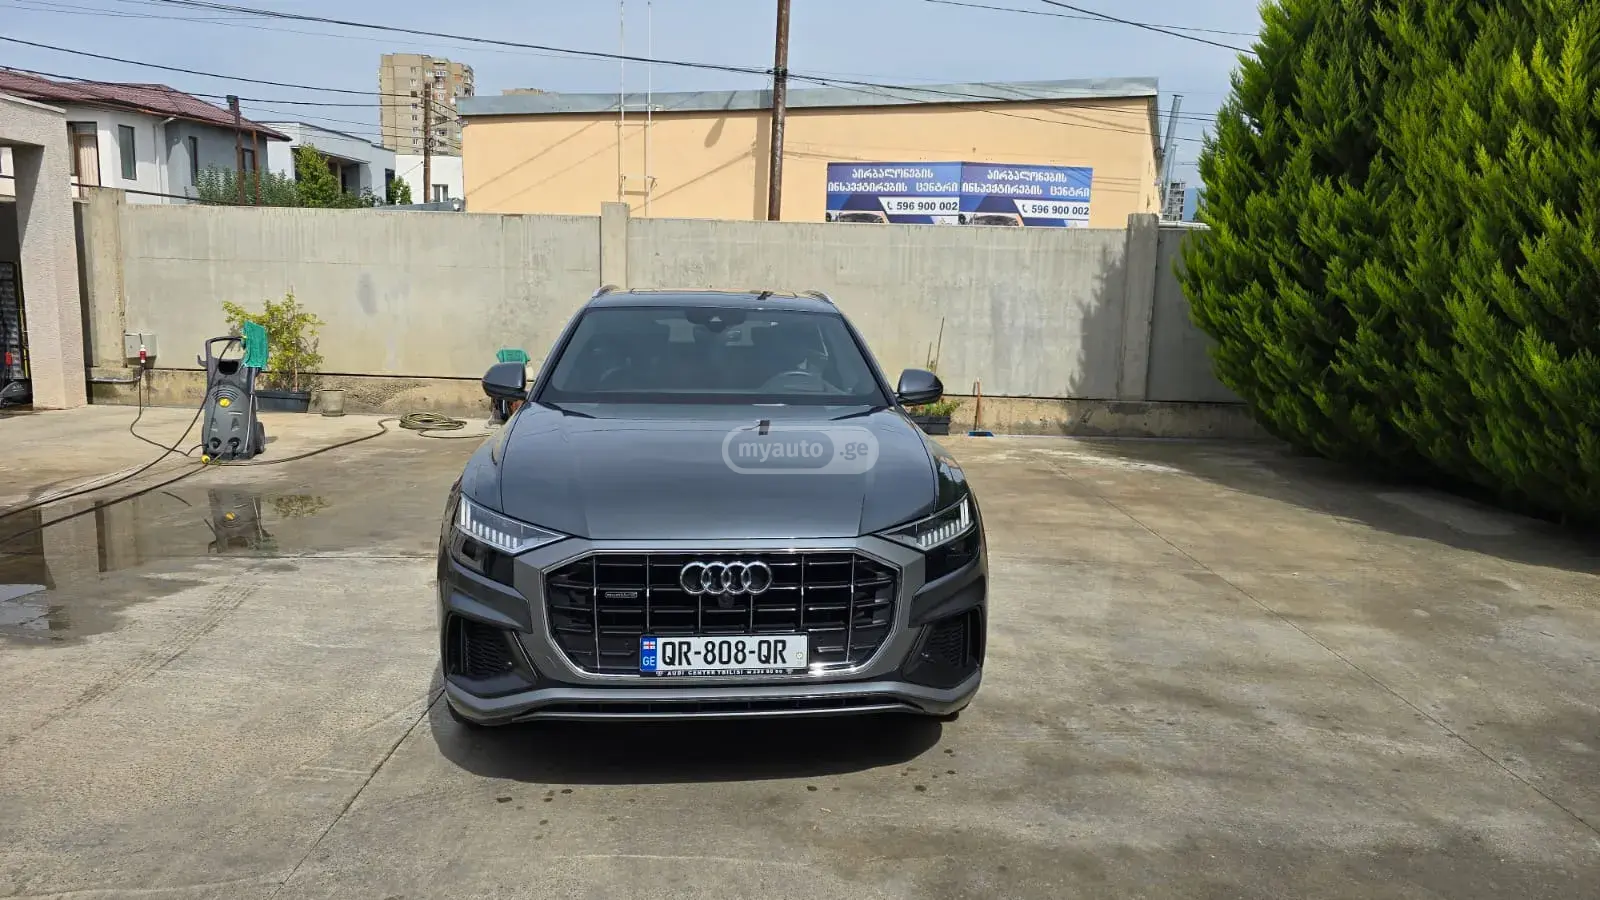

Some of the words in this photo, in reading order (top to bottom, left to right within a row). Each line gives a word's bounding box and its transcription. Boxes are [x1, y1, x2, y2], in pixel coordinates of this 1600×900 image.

[896, 202, 915, 211] 596
[918, 202, 936, 211] 900
[939, 202, 958, 211] 002
[1031, 205, 1049, 213] 596
[1052, 206, 1069, 215] 900
[1072, 206, 1089, 216] 002
[662, 640, 787, 666] QR-808-QR
[642, 656, 656, 666] GE
